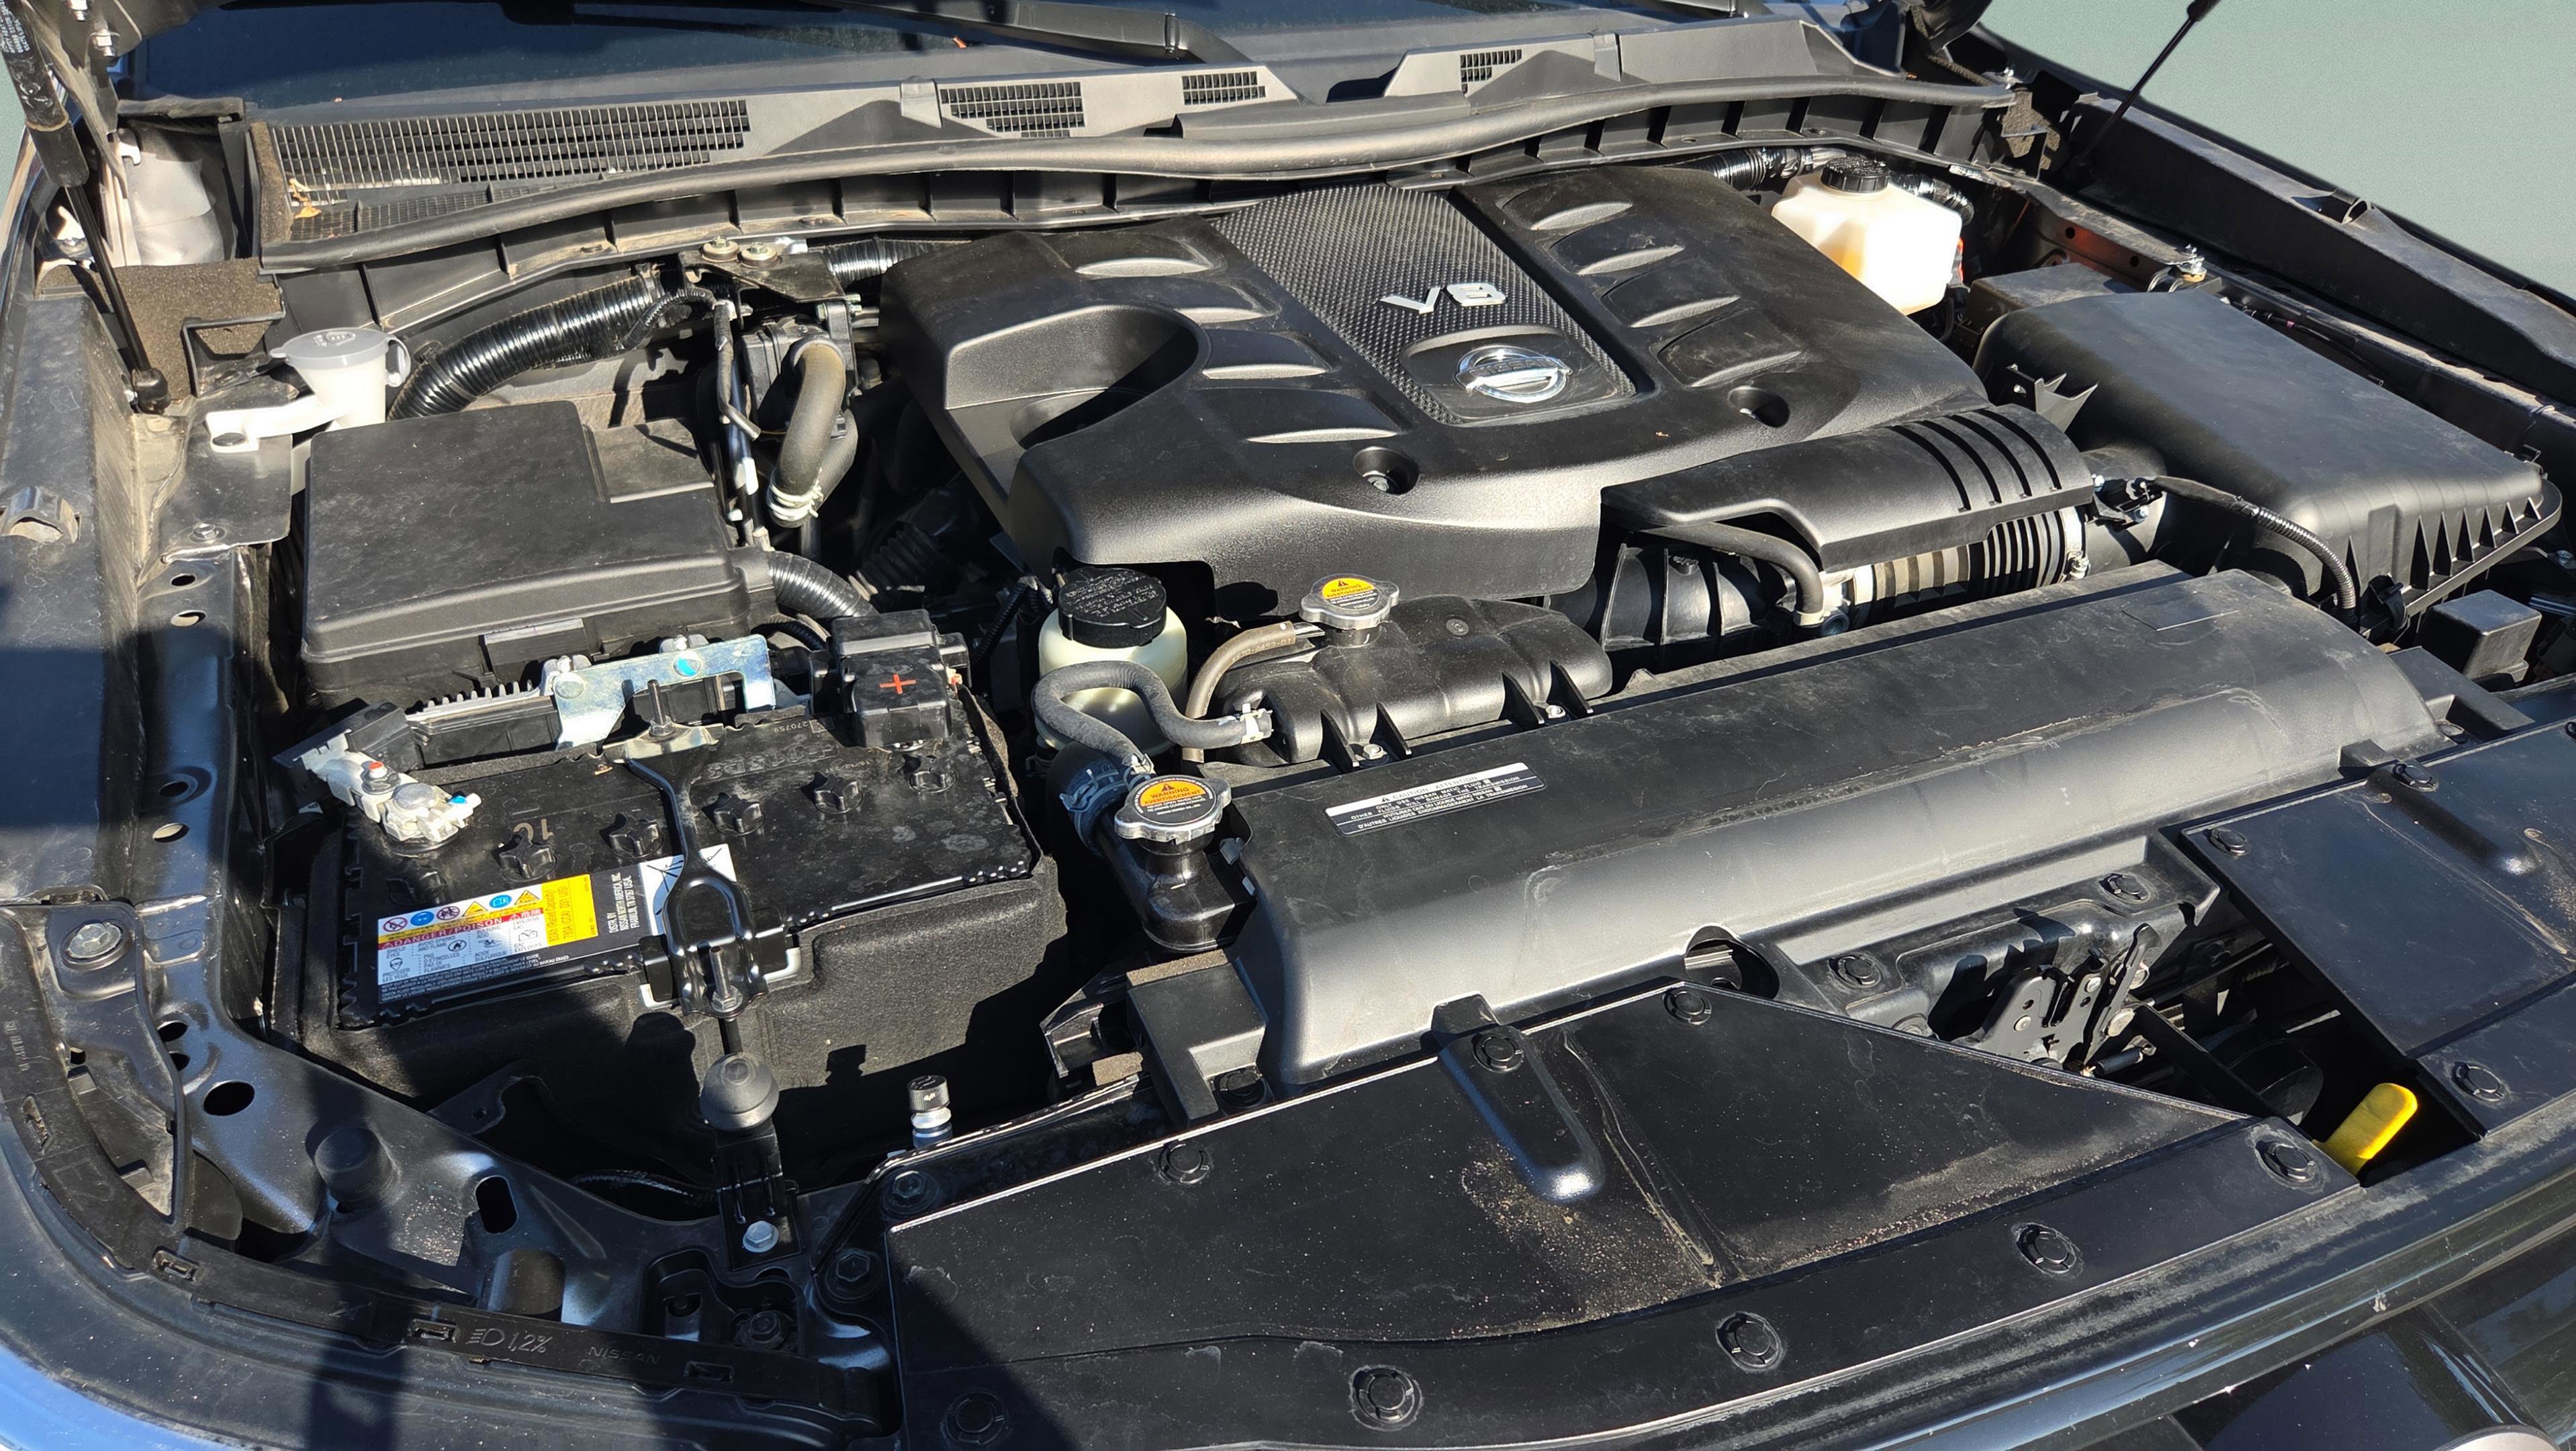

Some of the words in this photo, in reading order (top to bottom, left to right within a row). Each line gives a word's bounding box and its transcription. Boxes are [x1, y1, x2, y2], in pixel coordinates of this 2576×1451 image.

[1379, 282, 1507, 315] V8
[1151, 787, 1189, 799] WARNING
[1392, 788, 1429, 799] CAUTION
[1434, 776, 1478, 789] ATTENTION
[1144, 789, 1201, 805] AVERTISSEMENT
[616, 900, 626, 914] NORTH
[618, 914, 629, 930] NISSAN
[395, 917, 501, 947] DANGER/POISON
[588, 1346, 661, 1365] NISSAN
